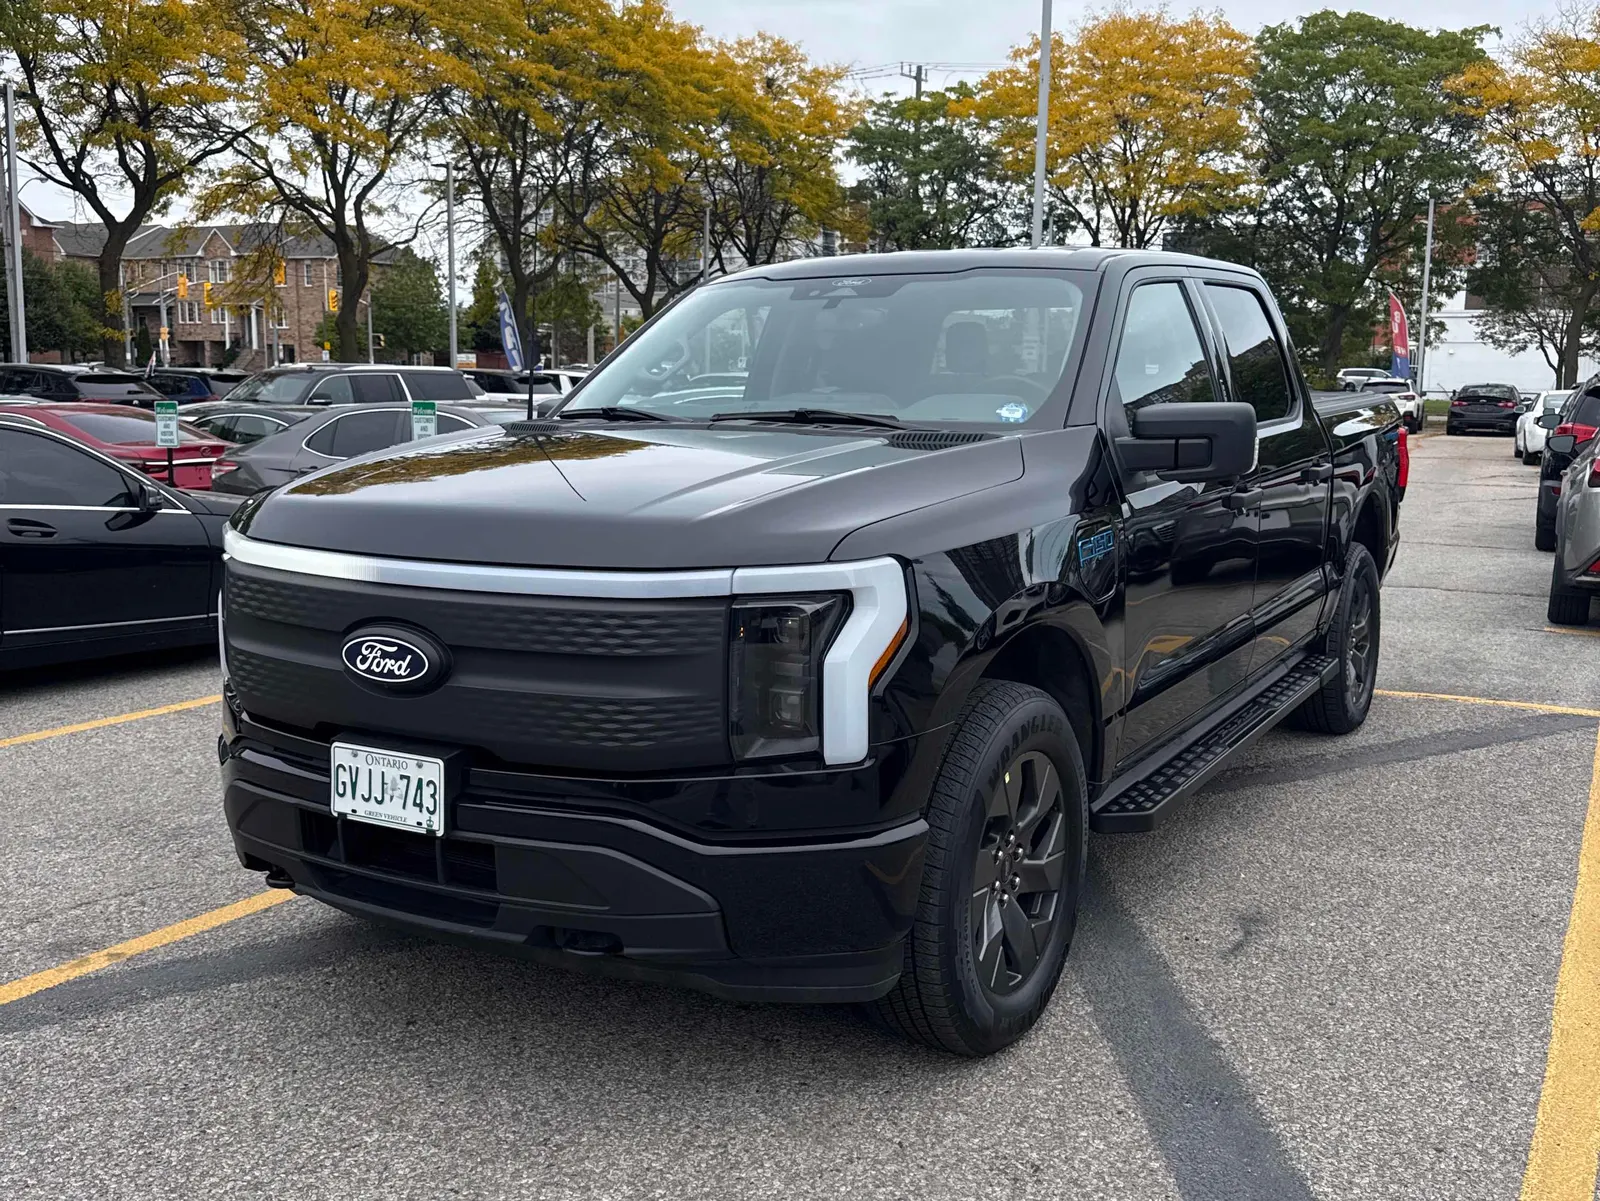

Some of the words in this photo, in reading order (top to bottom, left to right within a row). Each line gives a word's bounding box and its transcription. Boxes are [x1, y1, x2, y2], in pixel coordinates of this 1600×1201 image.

[356, 641, 412, 676] Ford
[365, 753, 409, 771] ONTARIO
[364, 809, 383, 819] GREEN
[383, 811, 408, 823] VEHICLE
